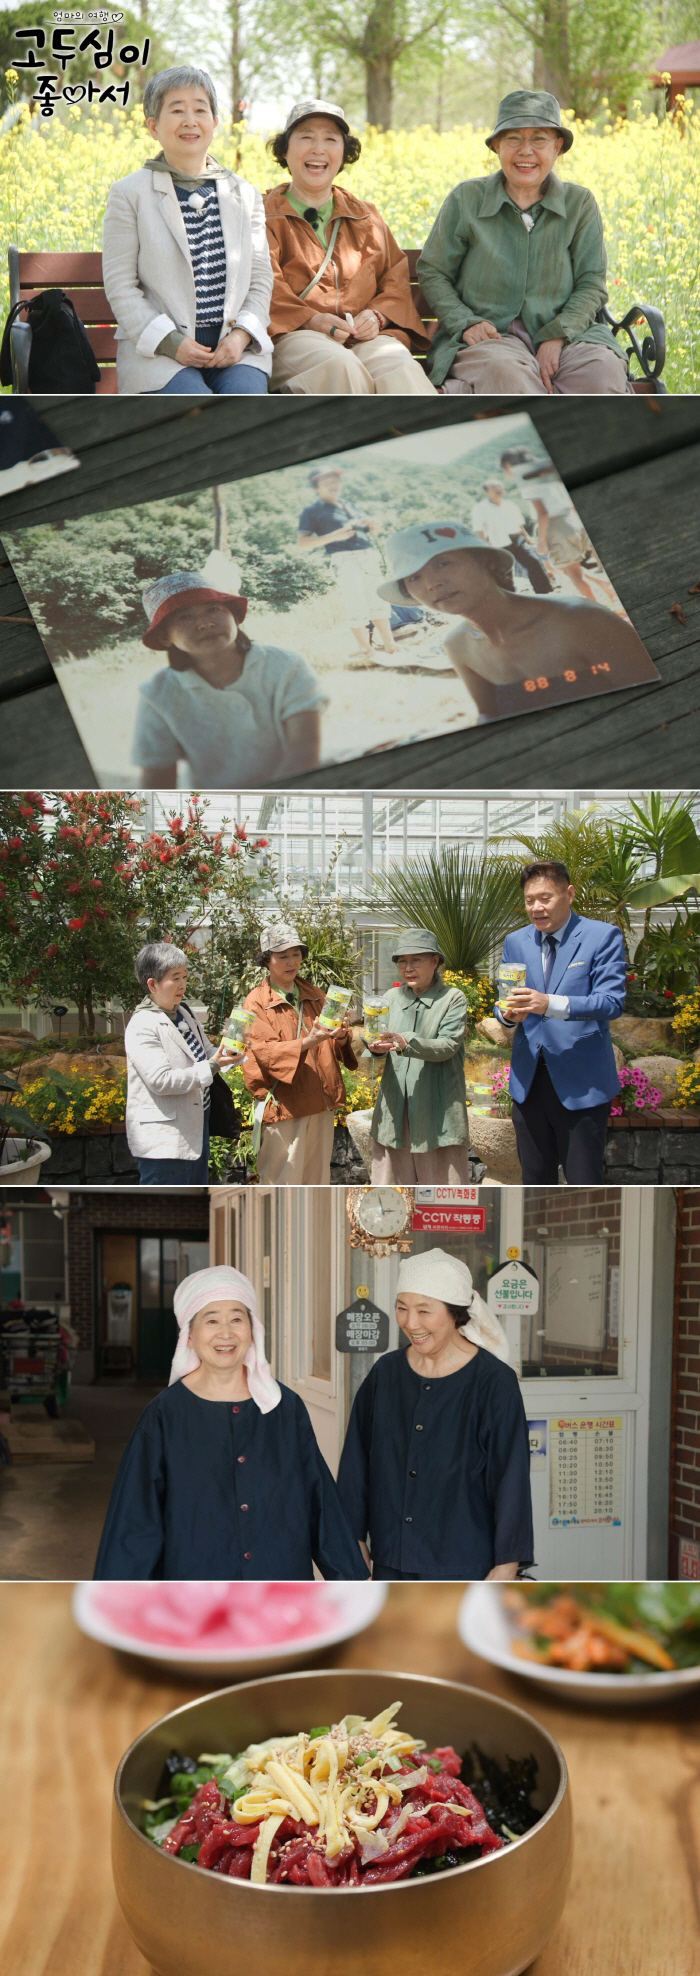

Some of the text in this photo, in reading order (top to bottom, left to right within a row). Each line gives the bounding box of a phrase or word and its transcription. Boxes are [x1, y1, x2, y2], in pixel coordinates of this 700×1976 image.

[422, 1212, 481, 1224] CCTV 작동중
[502, 1279, 528, 1290] 요금은
[494, 1289, 533, 1299] 선불입니다
[346, 1312, 381, 1323] 매장오픈
[346, 1329, 381, 1340] 매장마감
[580, 1421, 594, 1429] 운행
[595, 1420, 615, 1429] 시간표
